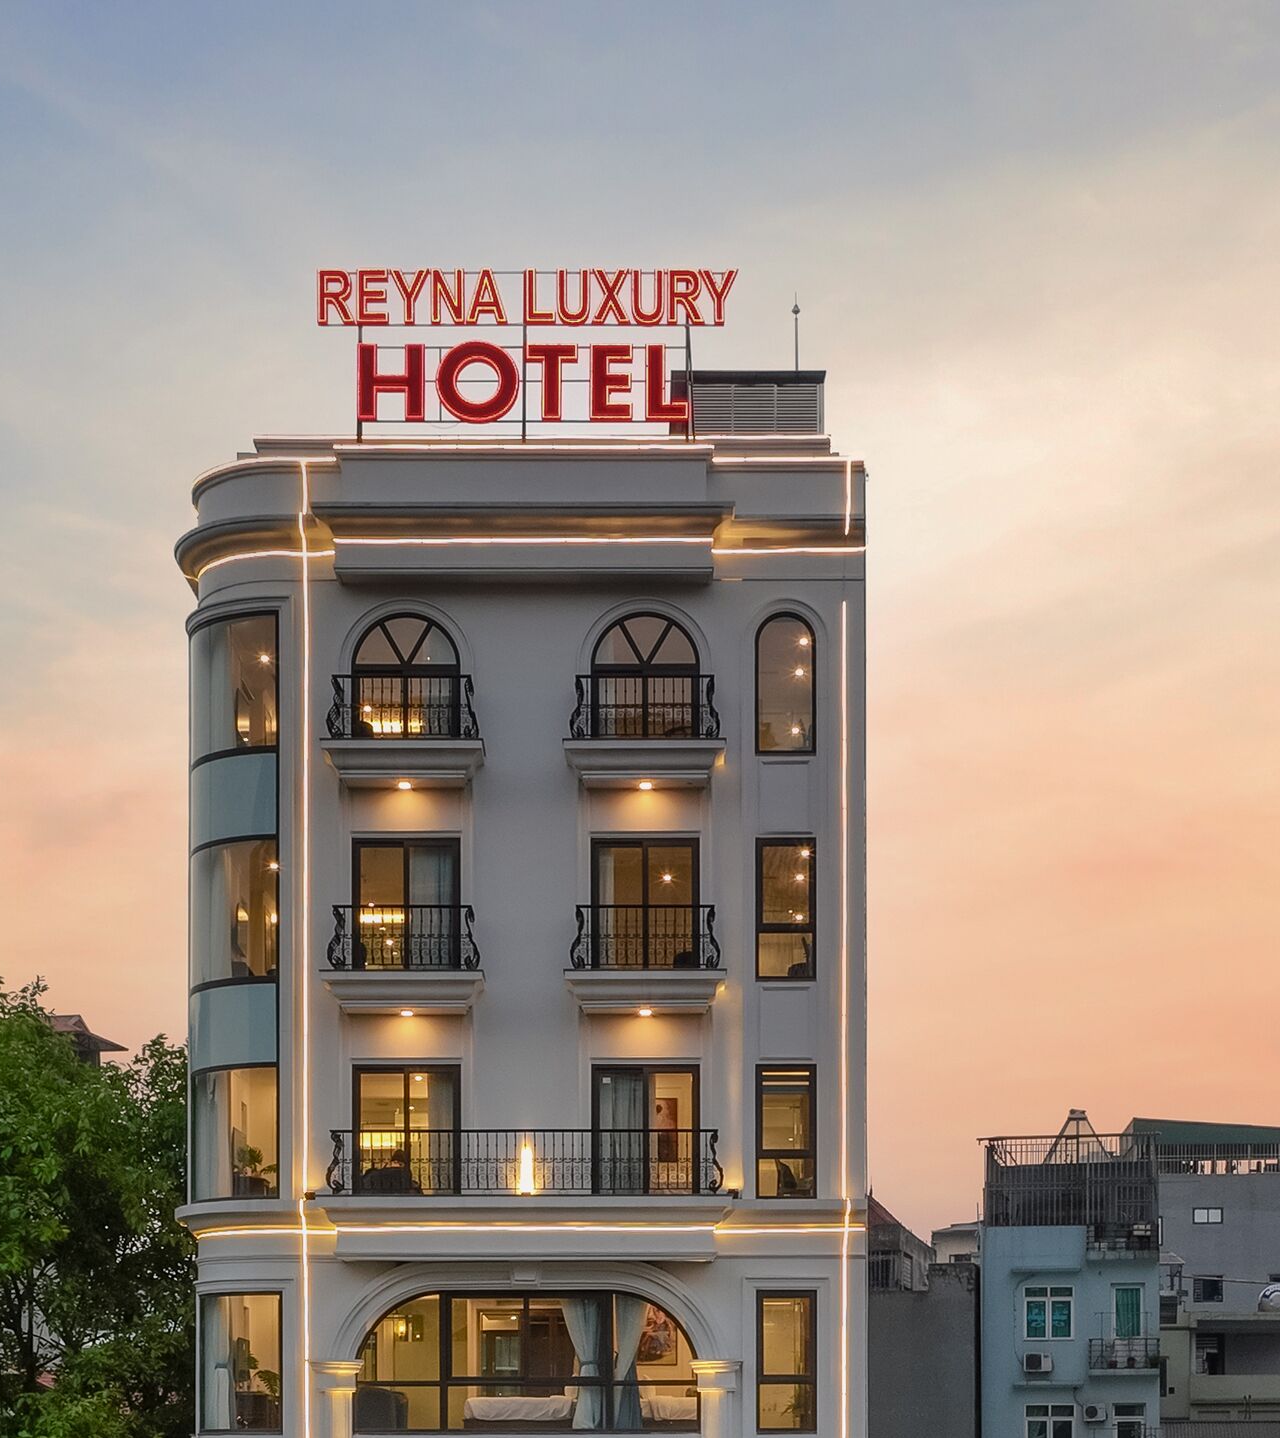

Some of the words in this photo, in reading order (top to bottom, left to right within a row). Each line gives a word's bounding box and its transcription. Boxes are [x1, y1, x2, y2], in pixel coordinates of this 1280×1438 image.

[317, 268, 507, 326] REYNA
[523, 267, 738, 326] LUXURY
[357, 340, 689, 424] HOTEL
